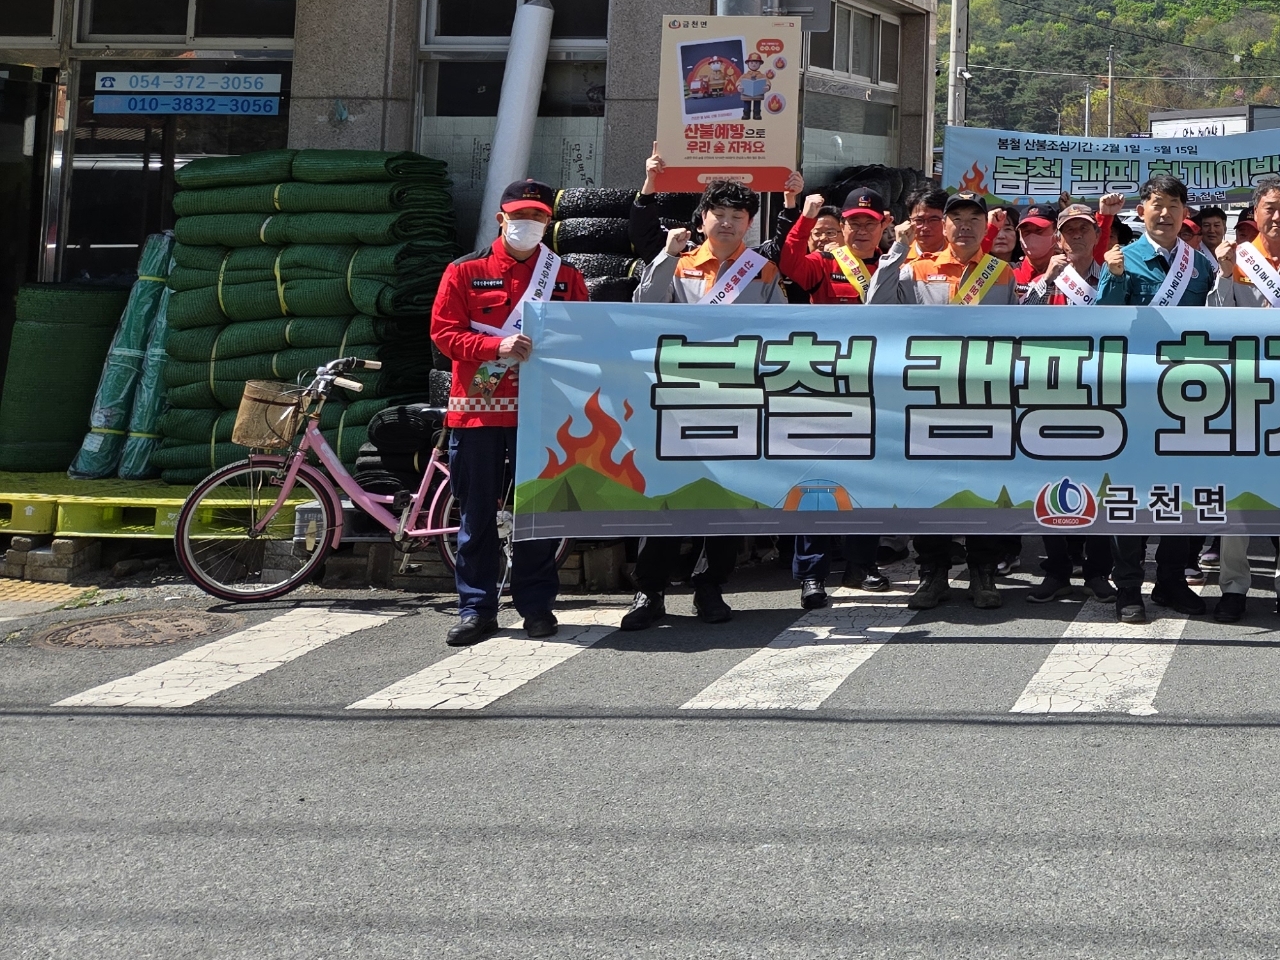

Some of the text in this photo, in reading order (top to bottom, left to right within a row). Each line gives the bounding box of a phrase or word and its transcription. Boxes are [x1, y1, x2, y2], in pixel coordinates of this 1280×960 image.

[128, 74, 264, 90] 054-372-3056
[127, 97, 273, 113] 010-3832-3056
[684, 123, 766, 140] 산불예방으로
[686, 140, 766, 154] 우리 숲 지켜요
[997, 137, 1022, 150] 봄철
[1024, 138, 1094, 153] 산불조심기간
[1101, 143, 1120, 154] 2월
[1124, 143, 1141, 154] 1일
[1153, 144, 1172, 155] 5월
[1175, 144, 1198, 156] 15일
[993, 155, 1063, 196] 봄철
[1070, 158, 1140, 196] 캠핑
[651, 331, 877, 461] 봄철
[903, 336, 1129, 461] 캠핑
[1103, 483, 1228, 524] 금천면
